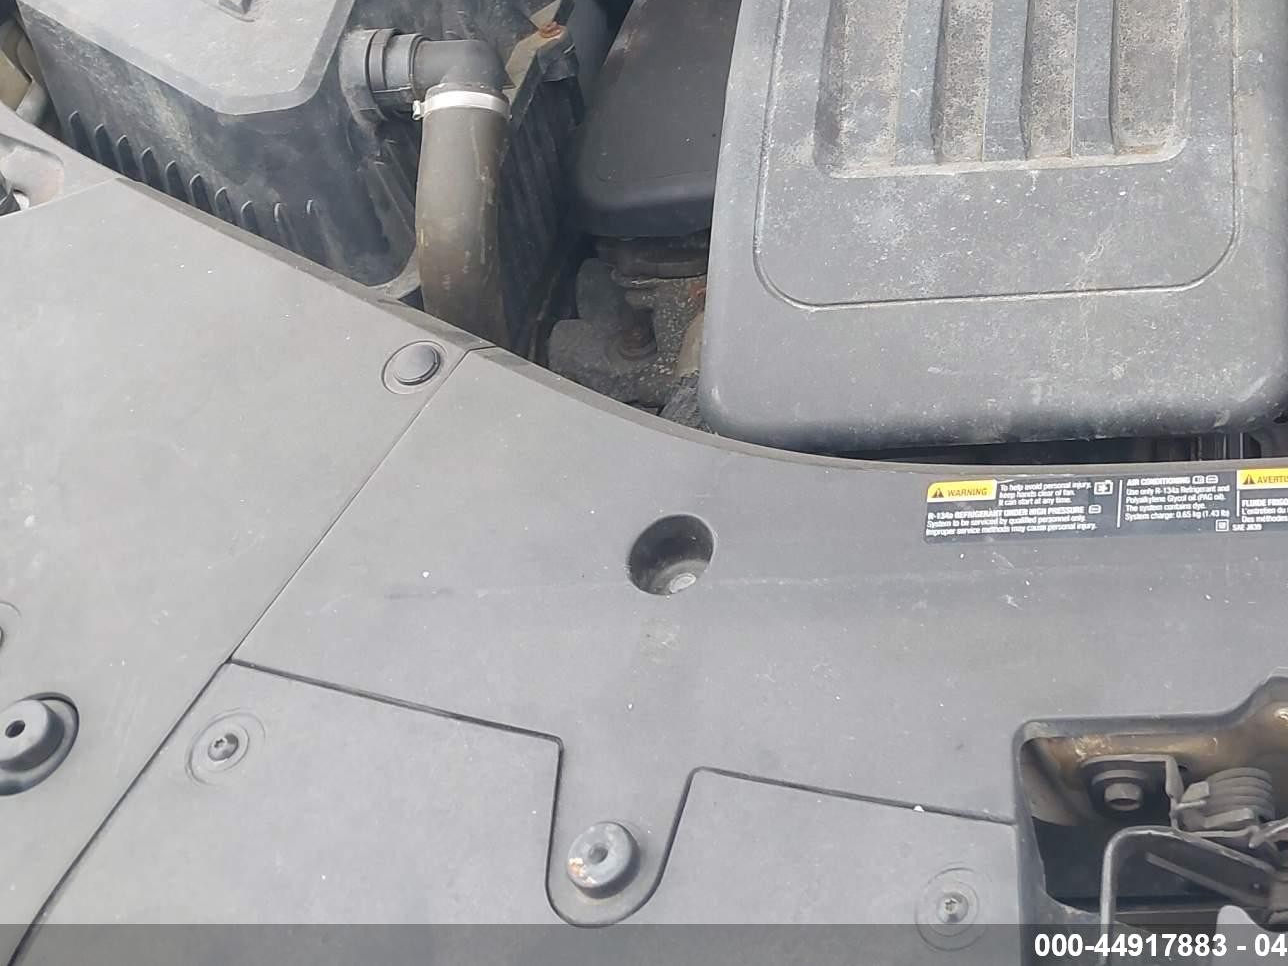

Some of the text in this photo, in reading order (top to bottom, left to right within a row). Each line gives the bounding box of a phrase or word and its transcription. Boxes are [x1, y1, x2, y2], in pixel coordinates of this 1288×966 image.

[1043, 482, 1071, 490] personal
[947, 488, 988, 497] WARNING
[1140, 488, 1154, 496] only
[1139, 504, 1163, 513] system
[1125, 513, 1150, 522] System
[1193, 510, 1202, 519] kg
[927, 521, 952, 529] System
[999, 518, 1008, 527] by
